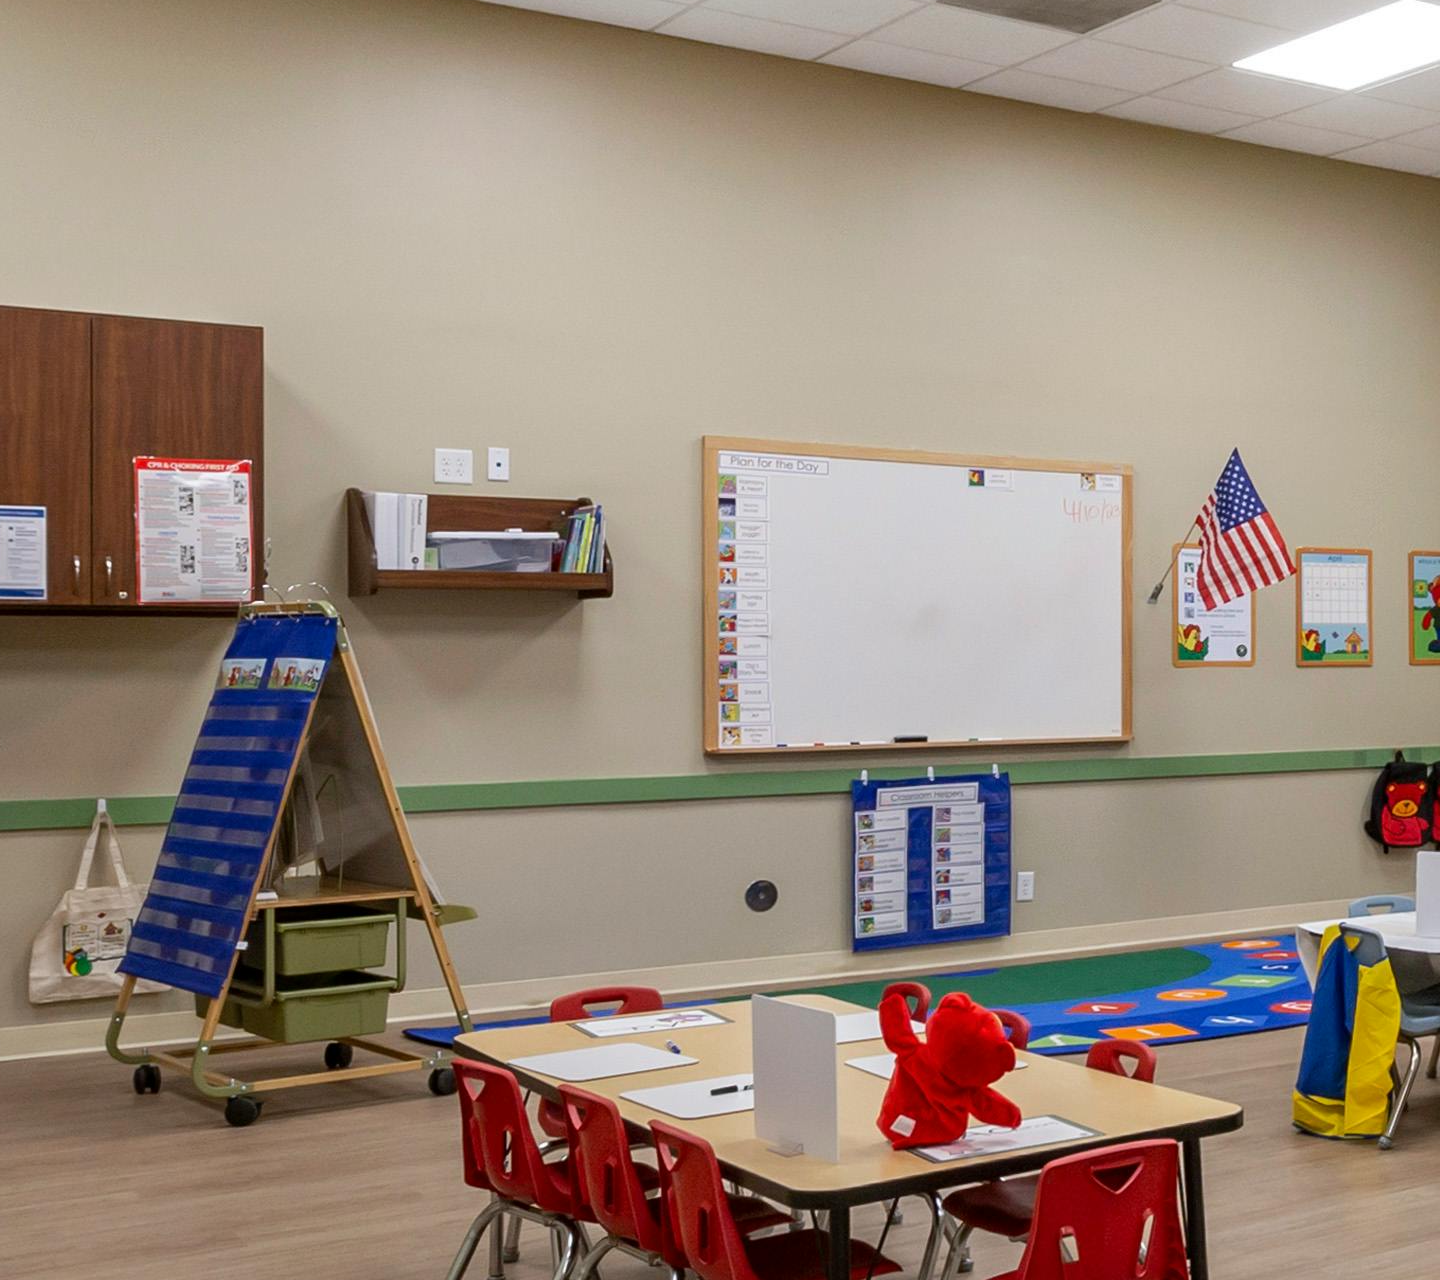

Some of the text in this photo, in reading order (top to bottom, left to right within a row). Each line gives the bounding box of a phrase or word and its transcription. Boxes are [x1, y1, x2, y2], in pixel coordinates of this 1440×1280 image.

[147, 461, 162, 469] CPR
[170, 462, 205, 470] CHOKING
[206, 463, 225, 471] FIRST
[730, 455, 820, 474] Plan for the Day
[890, 790, 964, 802] Classroom Helpers
